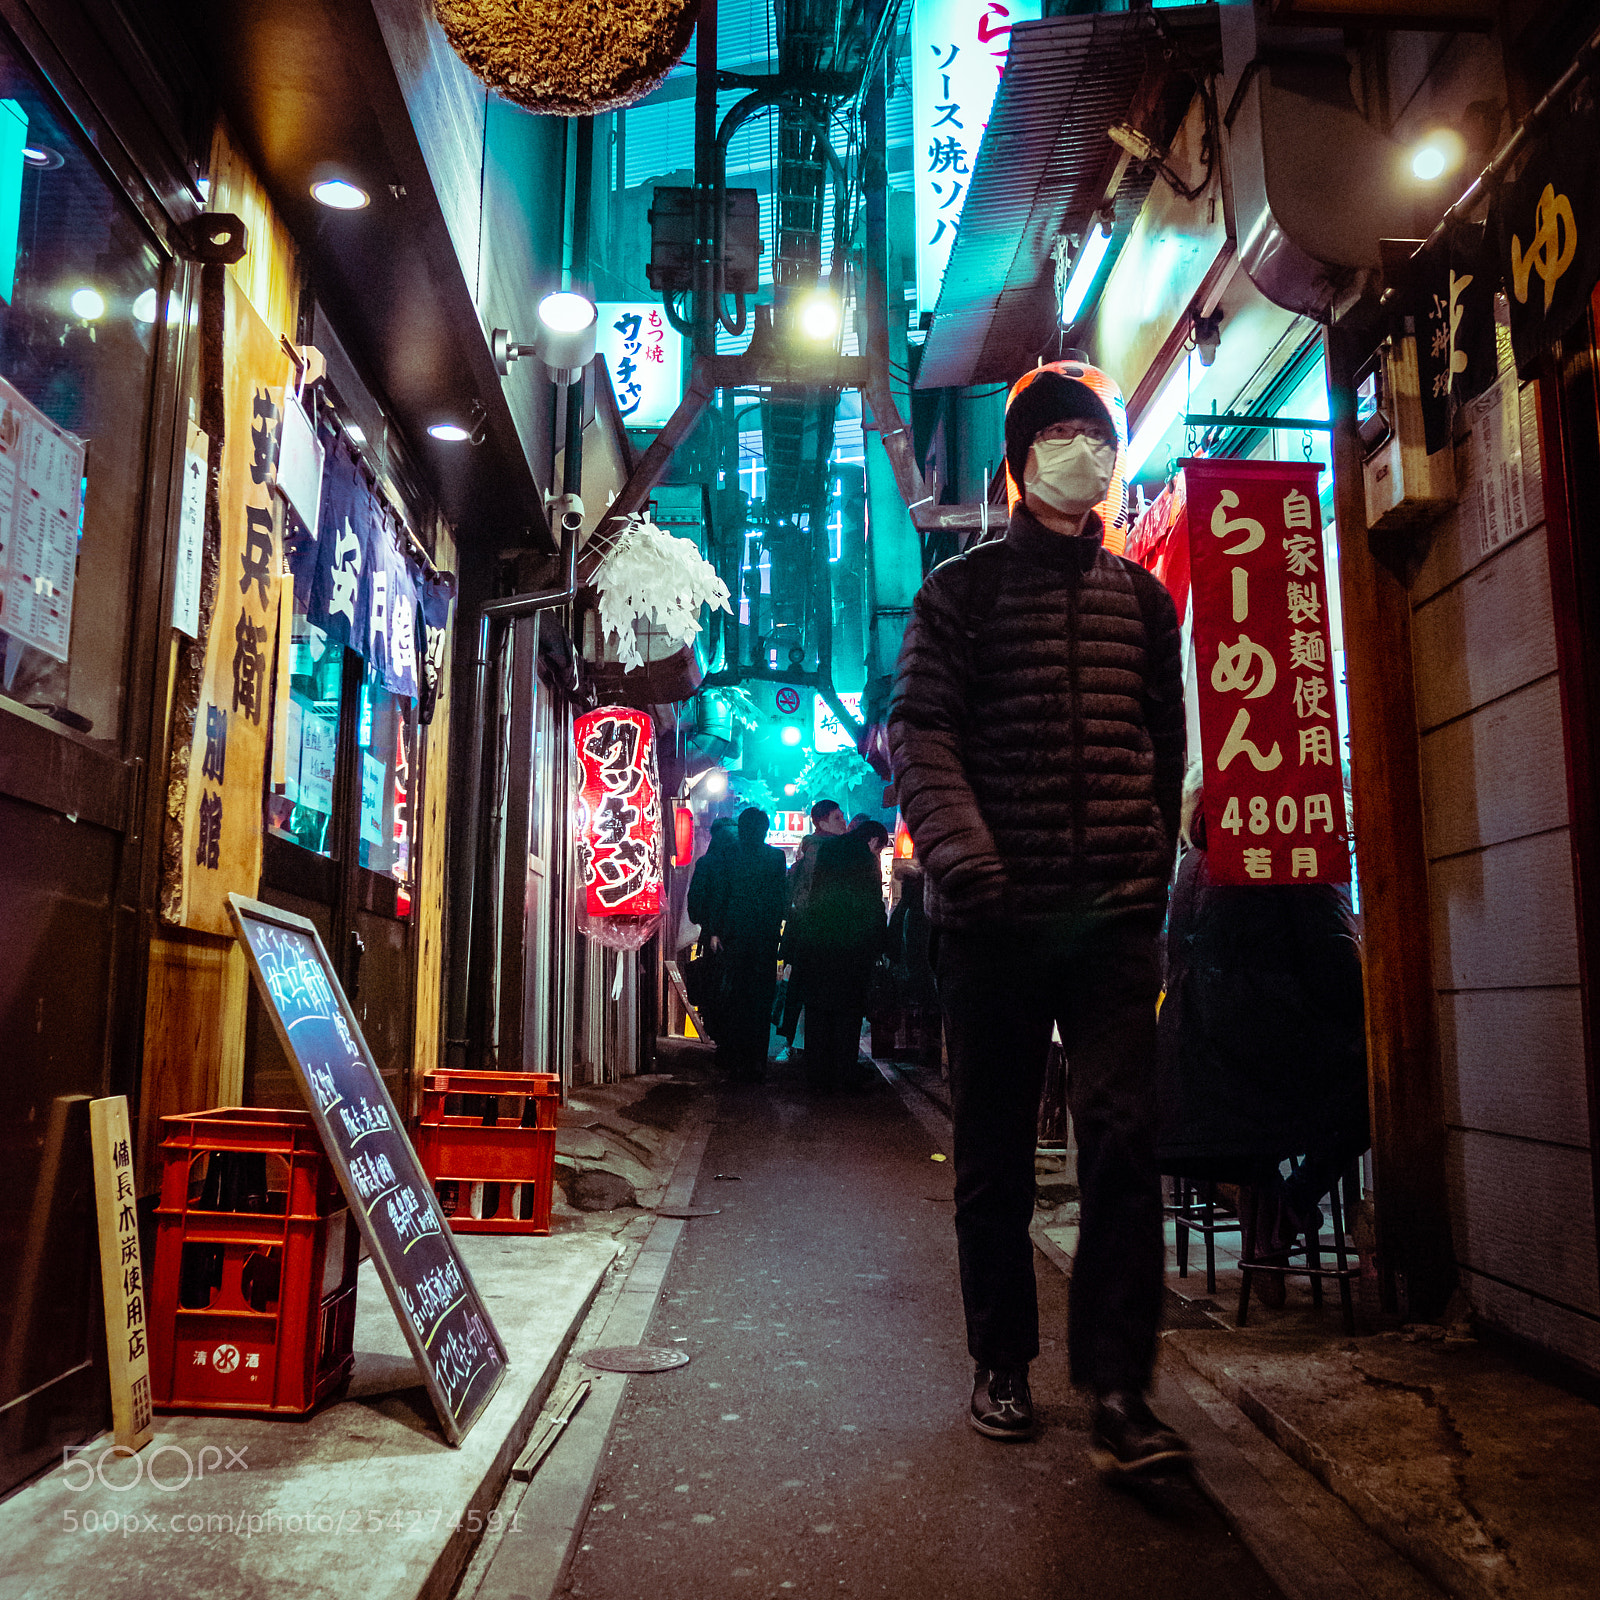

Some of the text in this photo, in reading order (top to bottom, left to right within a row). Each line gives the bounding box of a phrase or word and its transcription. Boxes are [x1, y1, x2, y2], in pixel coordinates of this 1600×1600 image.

[613, 312, 642, 419] ウッチャン
[646, 310, 664, 363] もつ焼
[1210, 489, 1283, 773] らーめん
[1283, 488, 1334, 767] 自家製麺使用
[1220, 794, 1335, 836] 480円
[112, 1139, 146, 1363] 備長木炭使用店
[245, 1353, 260, 1368] 酒
